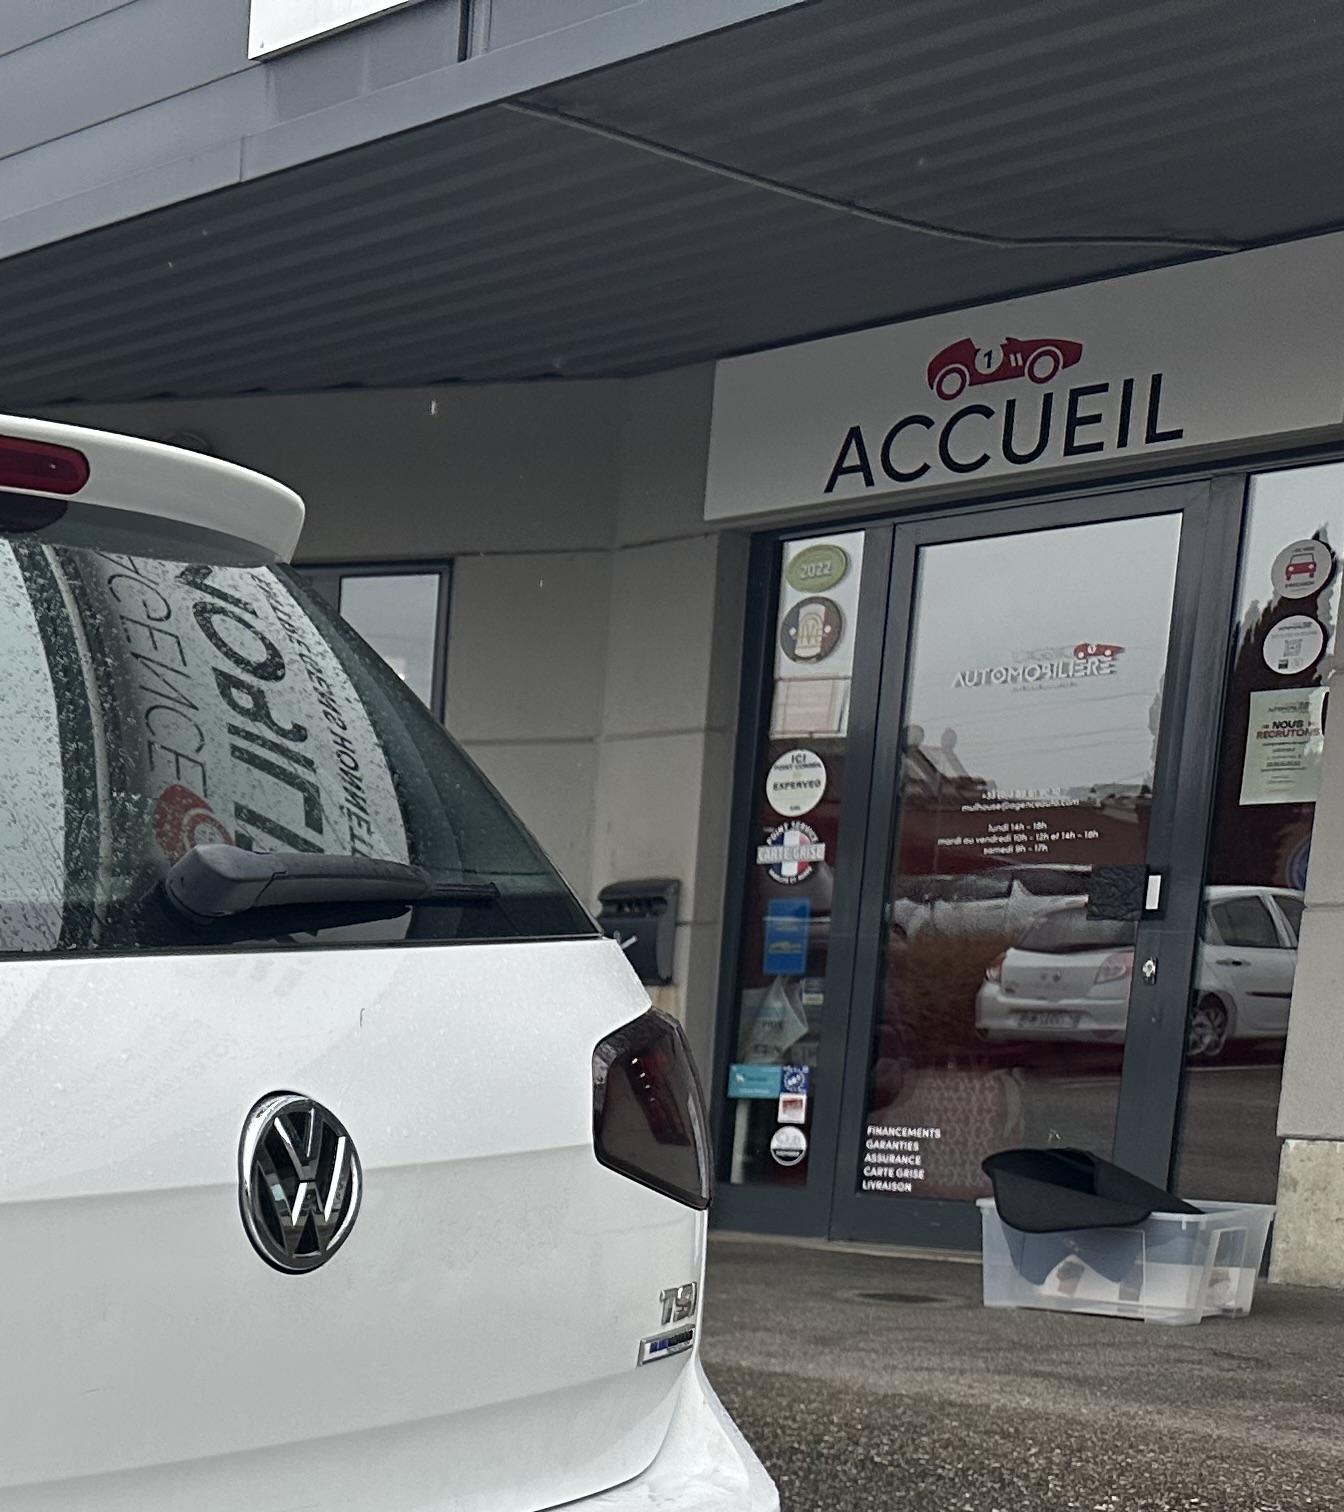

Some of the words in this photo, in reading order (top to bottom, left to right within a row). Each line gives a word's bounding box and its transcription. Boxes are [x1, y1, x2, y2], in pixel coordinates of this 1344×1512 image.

[823, 373, 1184, 493] ACCUEIL
[799, 561, 833, 580] 2022
[1272, 719, 1304, 729] NOUS
[1256, 728, 1320, 740] RECRUTONS
[791, 753, 807, 766] ICI
[866, 1125, 941, 1139] FINANCEMENTS
[865, 1138, 919, 1152] GARANTIES
[864, 1153, 921, 1166] ASSURANCE
[863, 1166, 894, 1178] CARTE
[895, 1167, 925, 1180] GRISE
[862, 1179, 912, 1192] LIVRAISON
